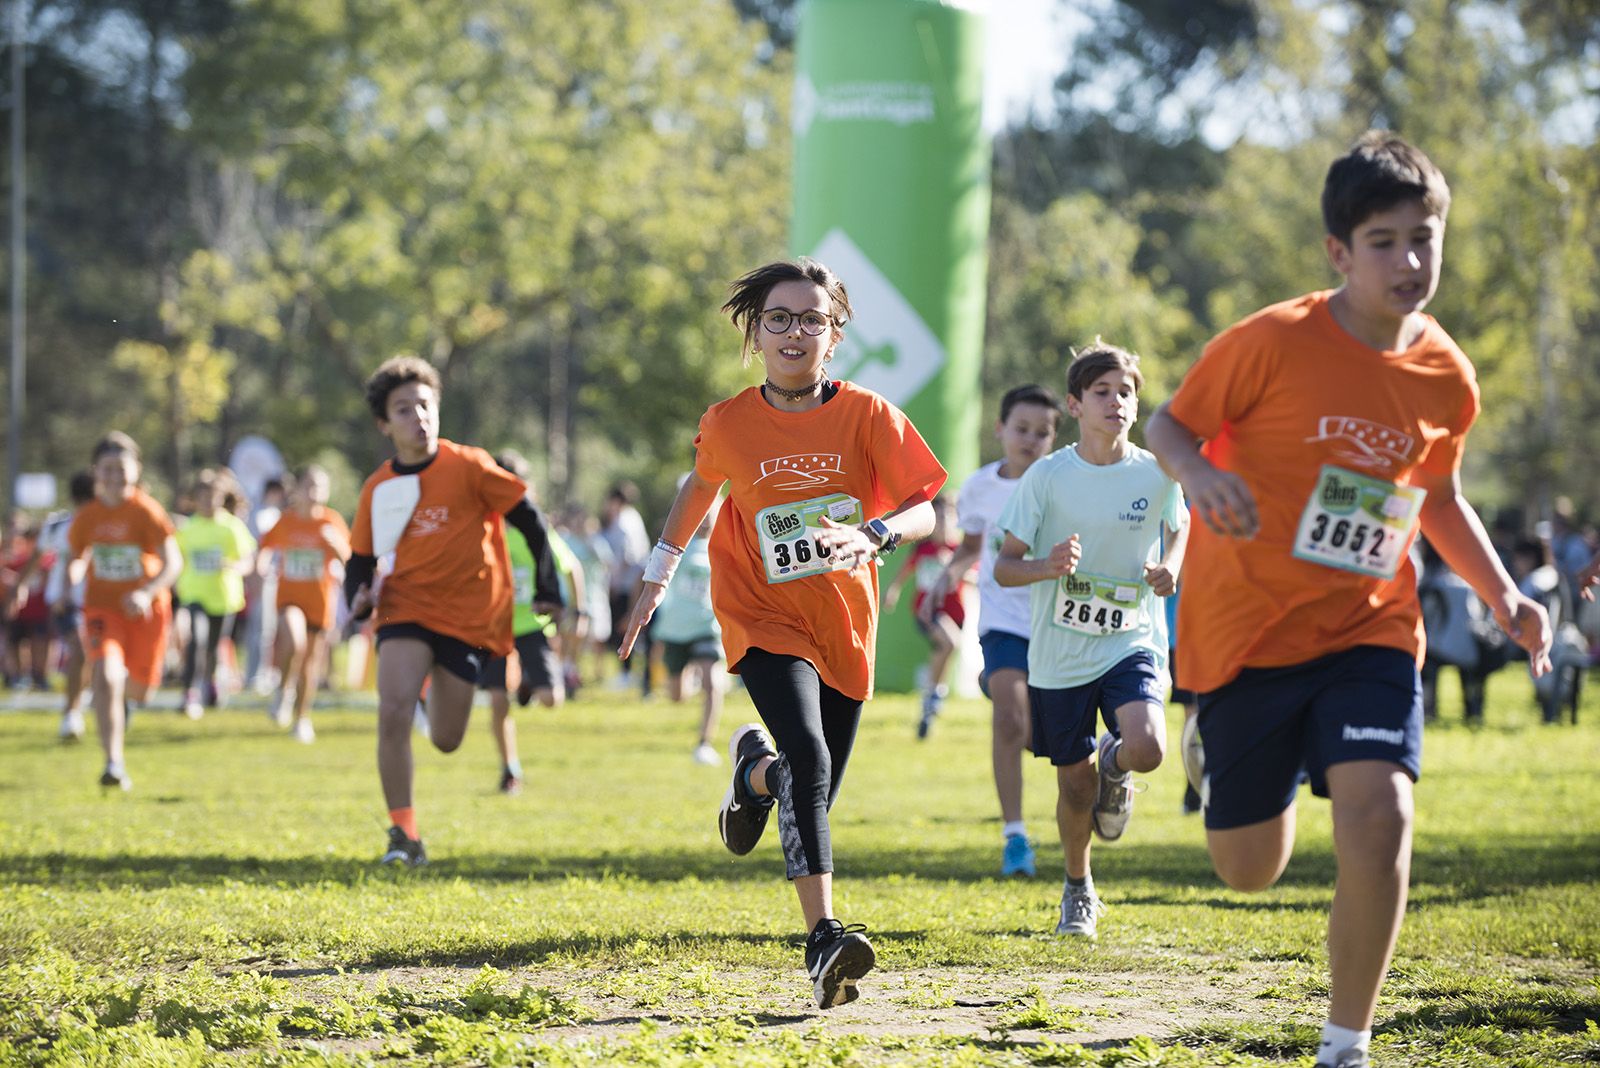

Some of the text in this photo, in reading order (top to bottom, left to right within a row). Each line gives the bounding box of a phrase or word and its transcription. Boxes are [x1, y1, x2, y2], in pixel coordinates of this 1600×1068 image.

[768, 513, 801, 536] CROS
[1311, 513, 1386, 557] 3652
[1066, 580, 1092, 594] CROS
[1062, 600, 1124, 629] 2649
